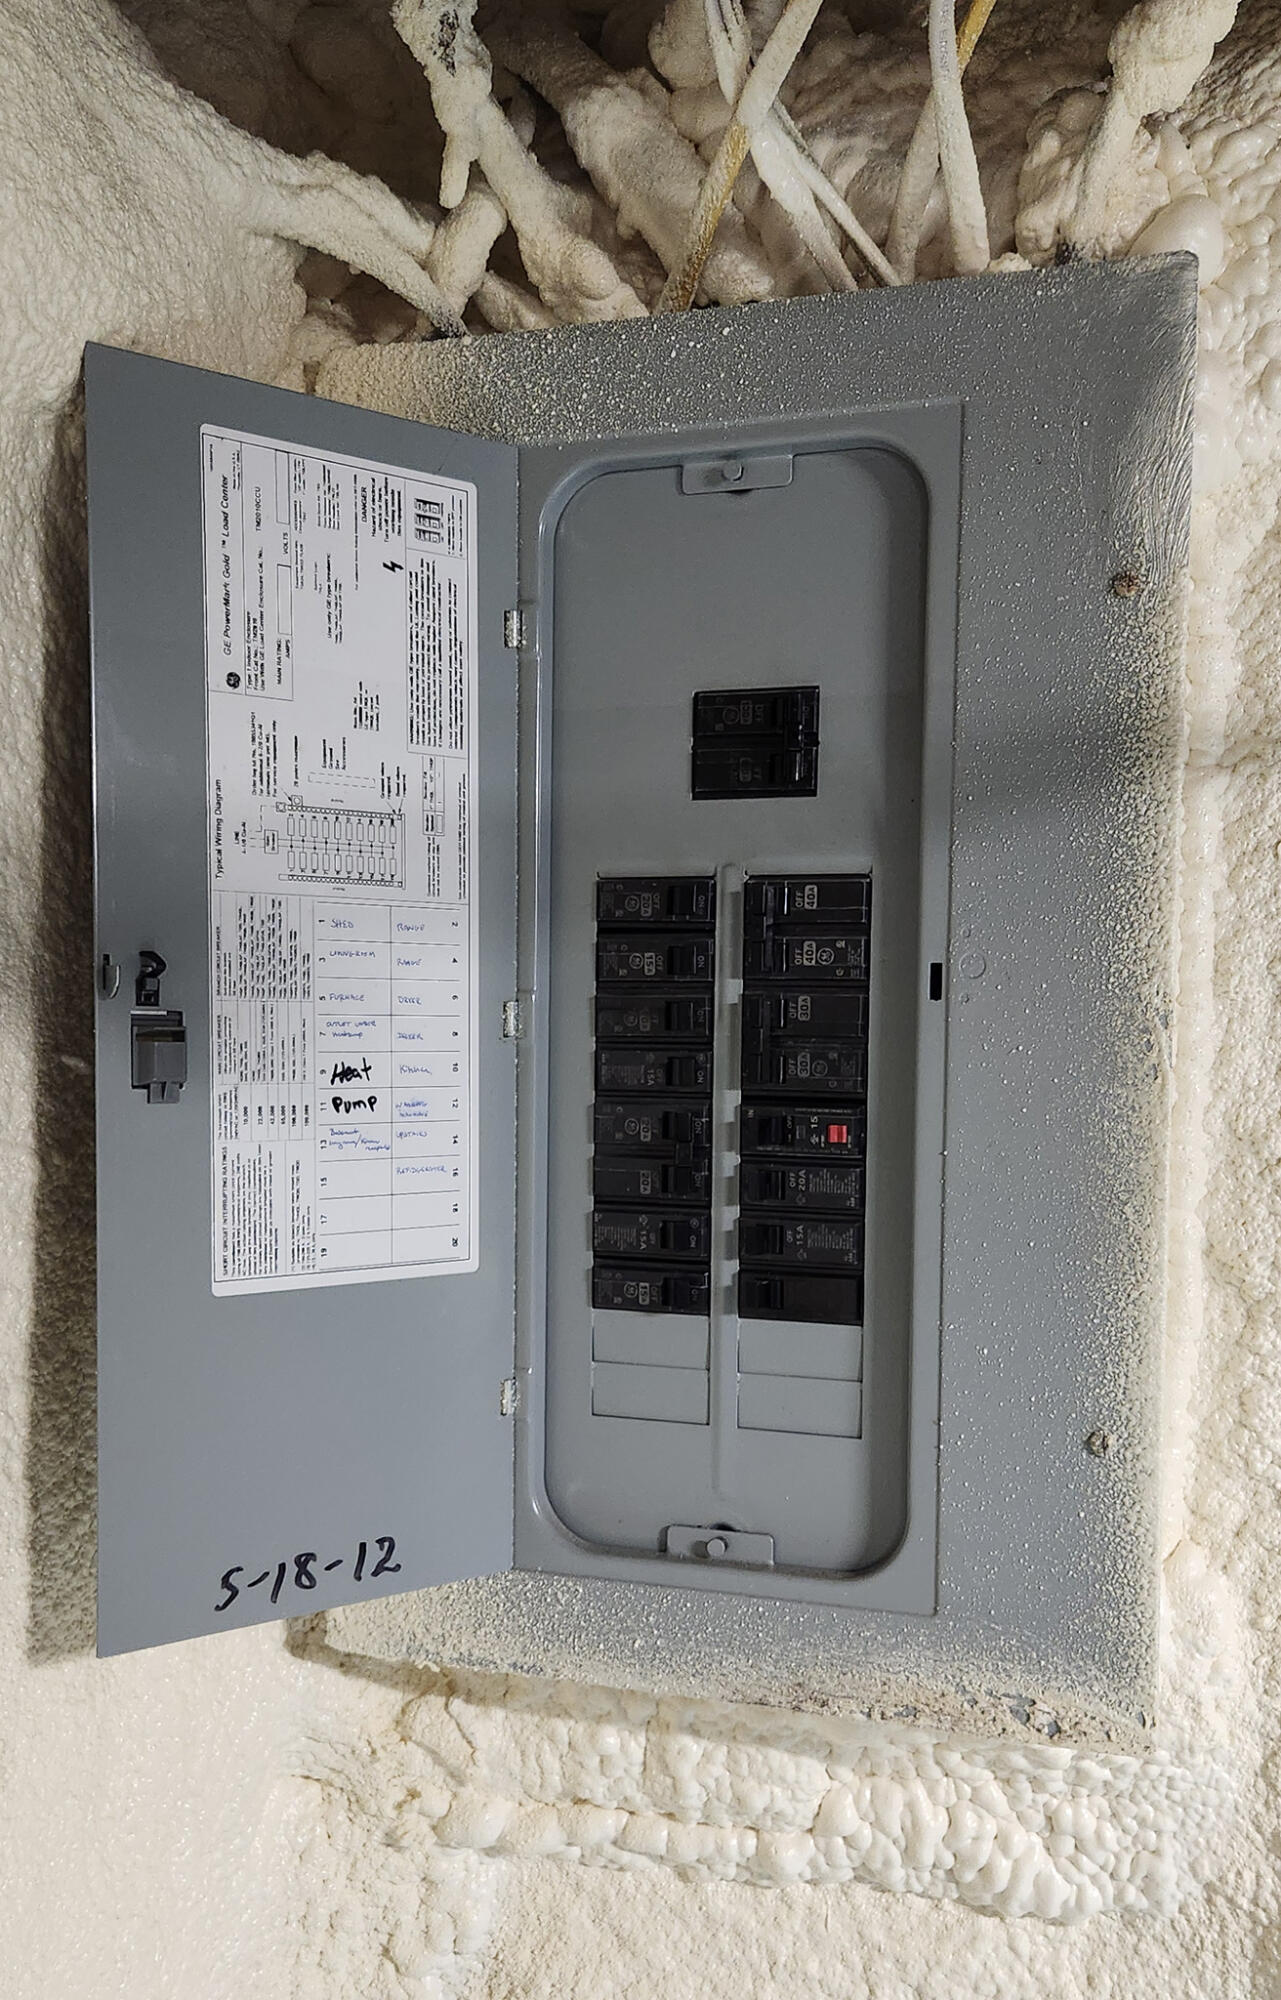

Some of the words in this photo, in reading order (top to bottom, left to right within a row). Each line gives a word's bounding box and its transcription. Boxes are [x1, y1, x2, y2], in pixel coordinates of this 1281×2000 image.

[220, 475, 229, 509] Center
[360, 486, 368, 523] DANGER
[220, 511, 230, 538] Load
[222, 554, 231, 579] Gold
[222, 582, 231, 639] PowerMark
[325, 599, 332, 609] GE
[223, 641, 231, 656] GE
[214, 779, 223, 815] Diagram
[214, 818, 224, 847] Wiring
[214, 849, 224, 879] Typical
[795, 890, 804, 908] OFF
[804, 886, 816, 909] 40A
[330, 918, 354, 929] SHED
[794, 947, 802, 965] OFF
[803, 941, 815, 965] 40A
[645, 953, 655, 975] 15A
[656, 955, 664, 971] OFF
[697, 955, 706, 968] ON
[788, 1001, 797, 1019] OFF
[798, 997, 809, 1019] 30A
[330, 1057, 372, 1086] Heat
[452, 1062, 458, 1072] 10
[788, 1058, 797, 1075] OFF
[798, 1053, 809, 1076] 30A
[647, 1069, 655, 1085] 15A
[696, 1070, 705, 1084] ON
[319, 1101, 327, 1111] 11
[452, 1098, 458, 1109] 12
[694, 1120, 702, 1134] ON
[810, 1116, 818, 1129] 15
[320, 1139, 327, 1150] 13
[452, 1135, 458, 1144] 14
[452, 1167, 458, 1177] 16
[788, 1172, 796, 1188] OFF
[320, 1177, 327, 1187] 15
[641, 1171, 650, 1193] 20A
[798, 1169, 806, 1192] 20A
[452, 1203, 458, 1213] 18
[320, 1214, 327, 1224] 17
[452, 1237, 458, 1246] 20
[639, 1231, 647, 1250] 15A
[689, 1235, 697, 1248] ON
[796, 1225, 804, 1245] 15A
[320, 1247, 327, 1257] 19
